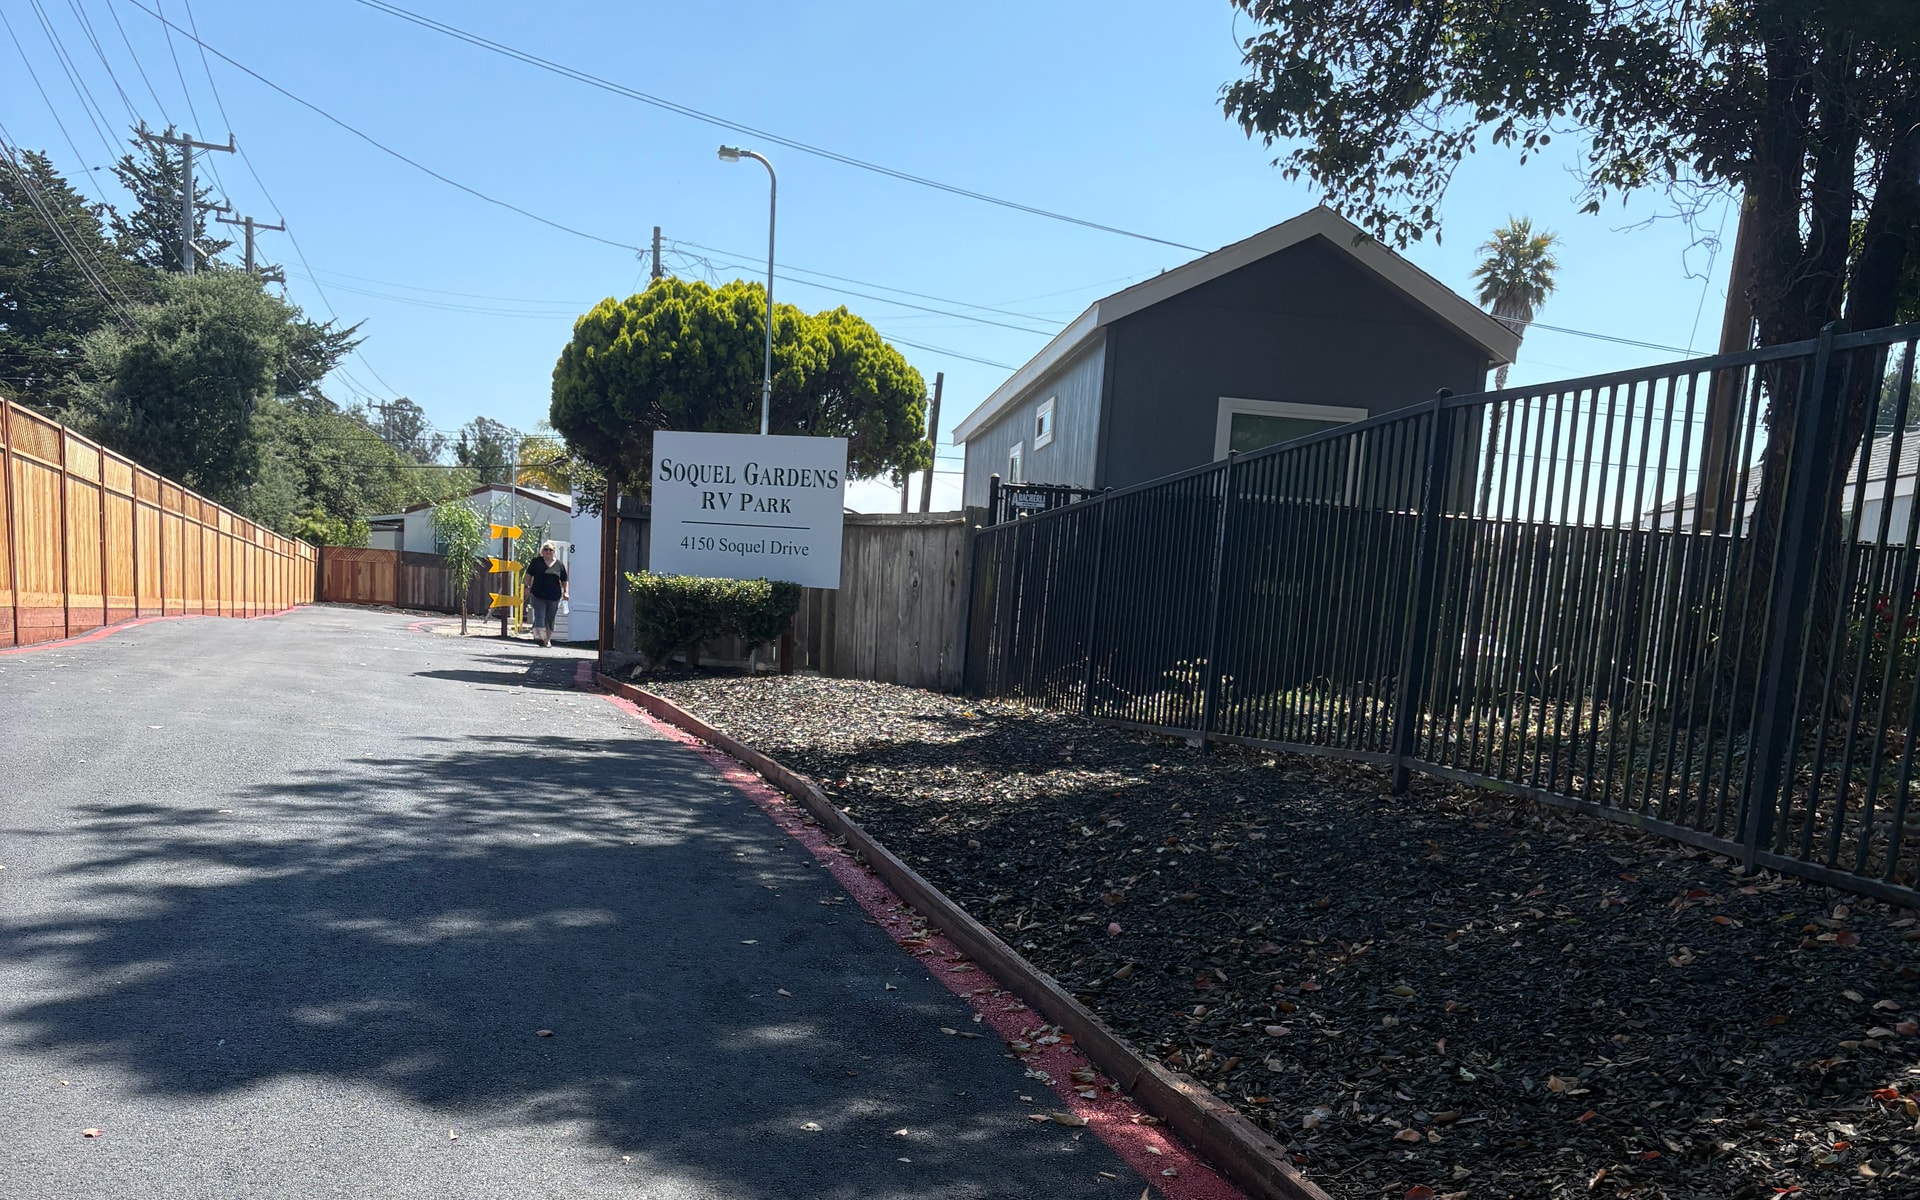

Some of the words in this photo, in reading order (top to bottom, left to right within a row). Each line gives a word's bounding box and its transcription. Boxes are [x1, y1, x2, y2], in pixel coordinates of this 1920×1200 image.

[659, 458, 736, 487] SOQUEL
[744, 462, 839, 489] GARDENS
[701, 491, 734, 511] RV
[740, 493, 792, 514] PARK
[569, 544, 576, 554] 8
[680, 536, 715, 551] 4150
[719, 538, 766, 557] Soquel
[770, 540, 810, 556] Drive
